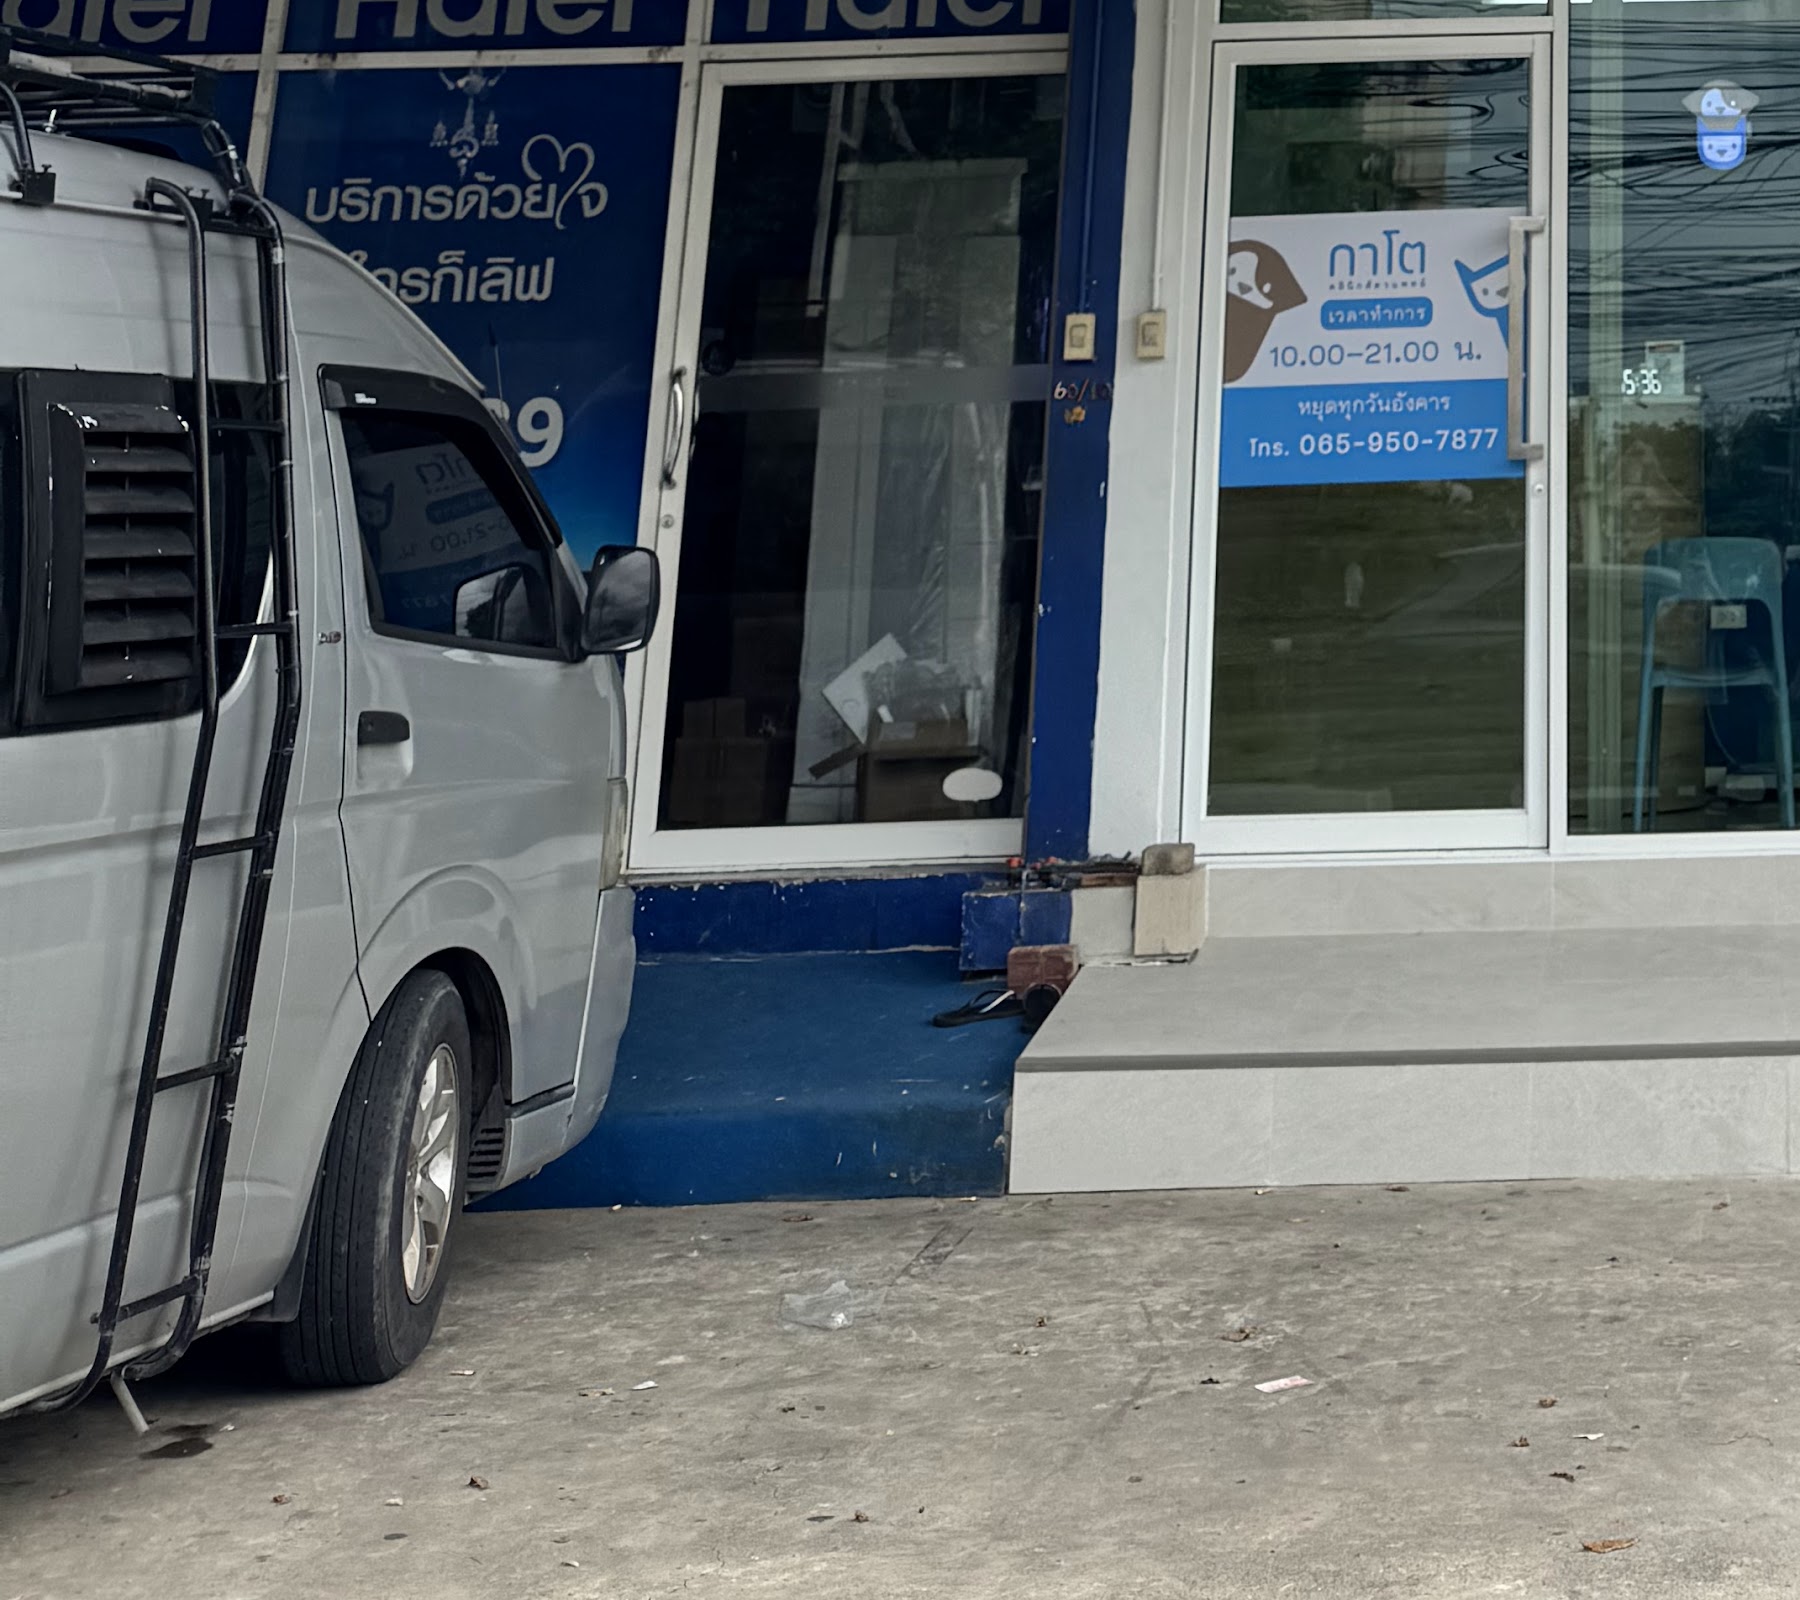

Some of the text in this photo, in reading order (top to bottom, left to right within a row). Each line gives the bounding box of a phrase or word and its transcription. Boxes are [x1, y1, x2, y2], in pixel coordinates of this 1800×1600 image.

[1329, 230, 1426, 277] กาโต
[1328, 304, 1427, 324] เวลาทำการ
[1269, 340, 1482, 368] 10.00-21.00 น.
[1298, 391, 1451, 422] หยุดทุกวันอังคาร
[1249, 427, 1499, 459] โทร. 065-950-7877
